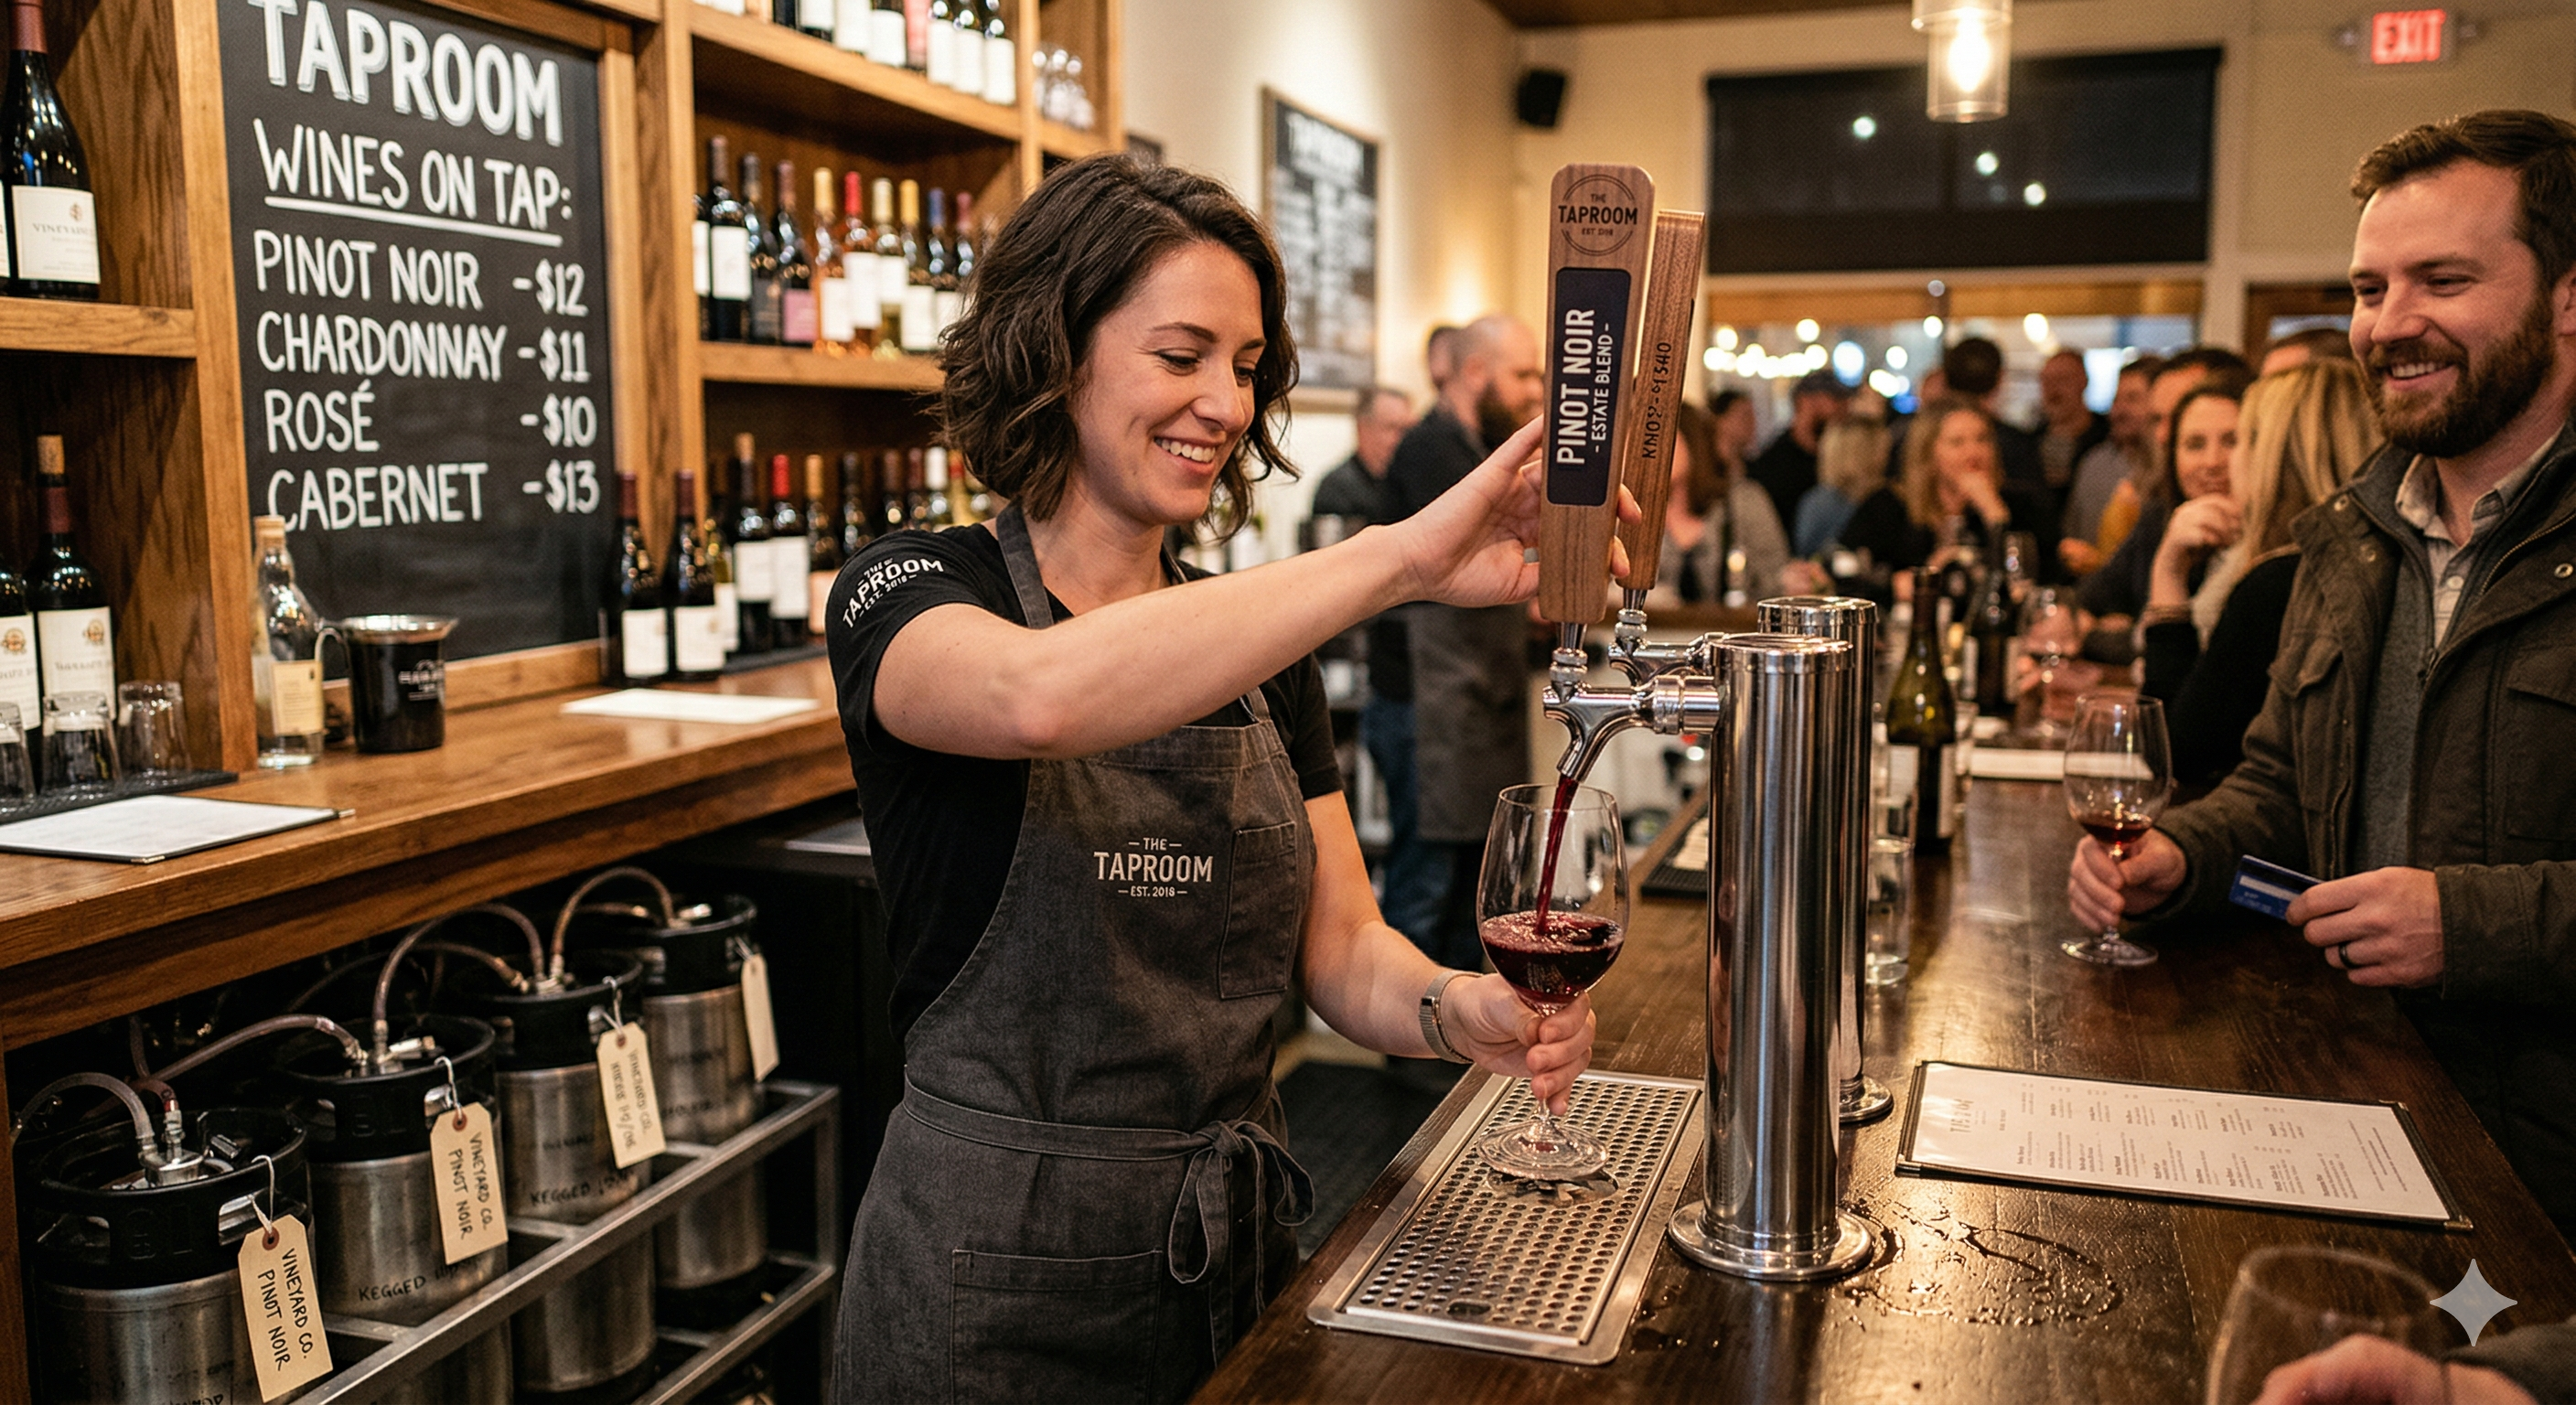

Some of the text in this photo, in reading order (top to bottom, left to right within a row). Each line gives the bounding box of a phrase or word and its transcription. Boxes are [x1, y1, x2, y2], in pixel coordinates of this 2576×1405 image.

[2371, 8, 2447, 64] EXIT
[247, 0, 564, 146] TAPROOM
[252, 117, 573, 231] WINES ON TAP:
[1558, 205, 1638, 225] TAPROOM
[253, 230, 377, 300] PINOT
[389, 244, 484, 311] NOIR
[256, 310, 508, 381] CHARDONNAY
[264, 379, 381, 454] ROSÉ
[1556, 309, 1595, 465] PINOT NOIR
[1591, 334, 1614, 442] ESTATE BLEND
[268, 462, 488, 531] CABERNET
[843, 558, 944, 628] TAPROOM
[1093, 851, 1214, 883] TAPROOM
[1143, 837, 1168, 851] THE
[1130, 885, 1175, 897] EST. 2018
[448, 1148, 468, 1193] PINOT
[469, 1132, 490, 1203] VINEYARD
[456, 1200, 473, 1240] NOIR
[257, 1269, 291, 1371] PINOT NOIR
[282, 1248, 314, 1359] VINEYARD CO.
[358, 1275, 427, 1302] KEGGED
